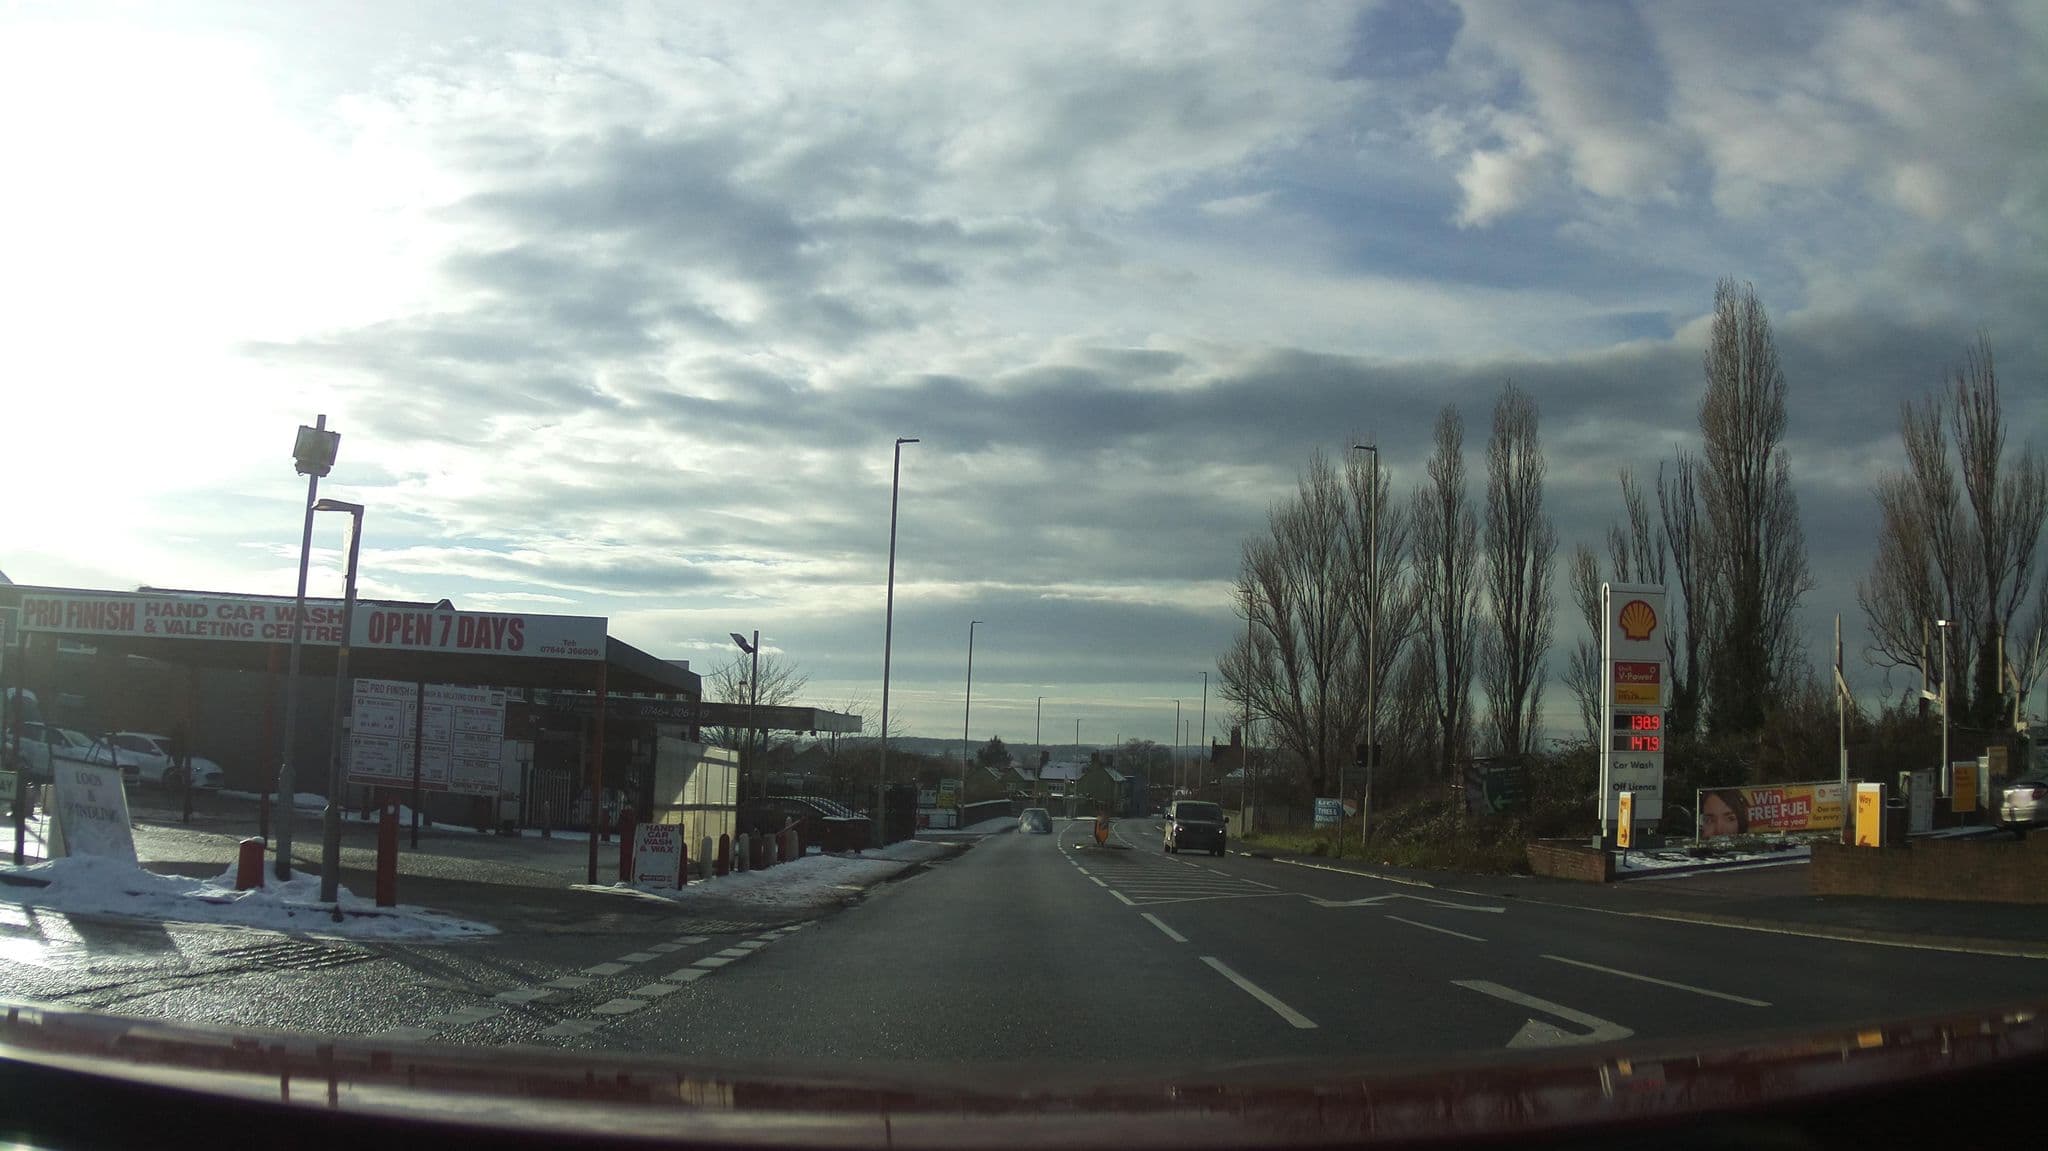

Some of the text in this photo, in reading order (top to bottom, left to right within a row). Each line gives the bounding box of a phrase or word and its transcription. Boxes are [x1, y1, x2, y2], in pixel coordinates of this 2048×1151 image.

[23, 599, 136, 631] PRO FINISH
[144, 602, 209, 618] HAND
[217, 604, 265, 621] CAR
[143, 618, 157, 633] &
[163, 620, 254, 638] VALETING
[368, 611, 524, 651] OPEN 7 DAYS
[1631, 715, 1660, 730] 138.9
[1631, 736, 1660, 751] 147.9
[1613, 760, 1654, 769] Car Wash
[1612, 782, 1657, 791] Off Licence
[1753, 791, 1781, 804] Win
[1747, 801, 1810, 821] FREE FUEL
[646, 824, 675, 832] HAND
[1771, 818, 1782, 827] for
[1790, 818, 1807, 827] year
[651, 845, 674, 853] WAX
